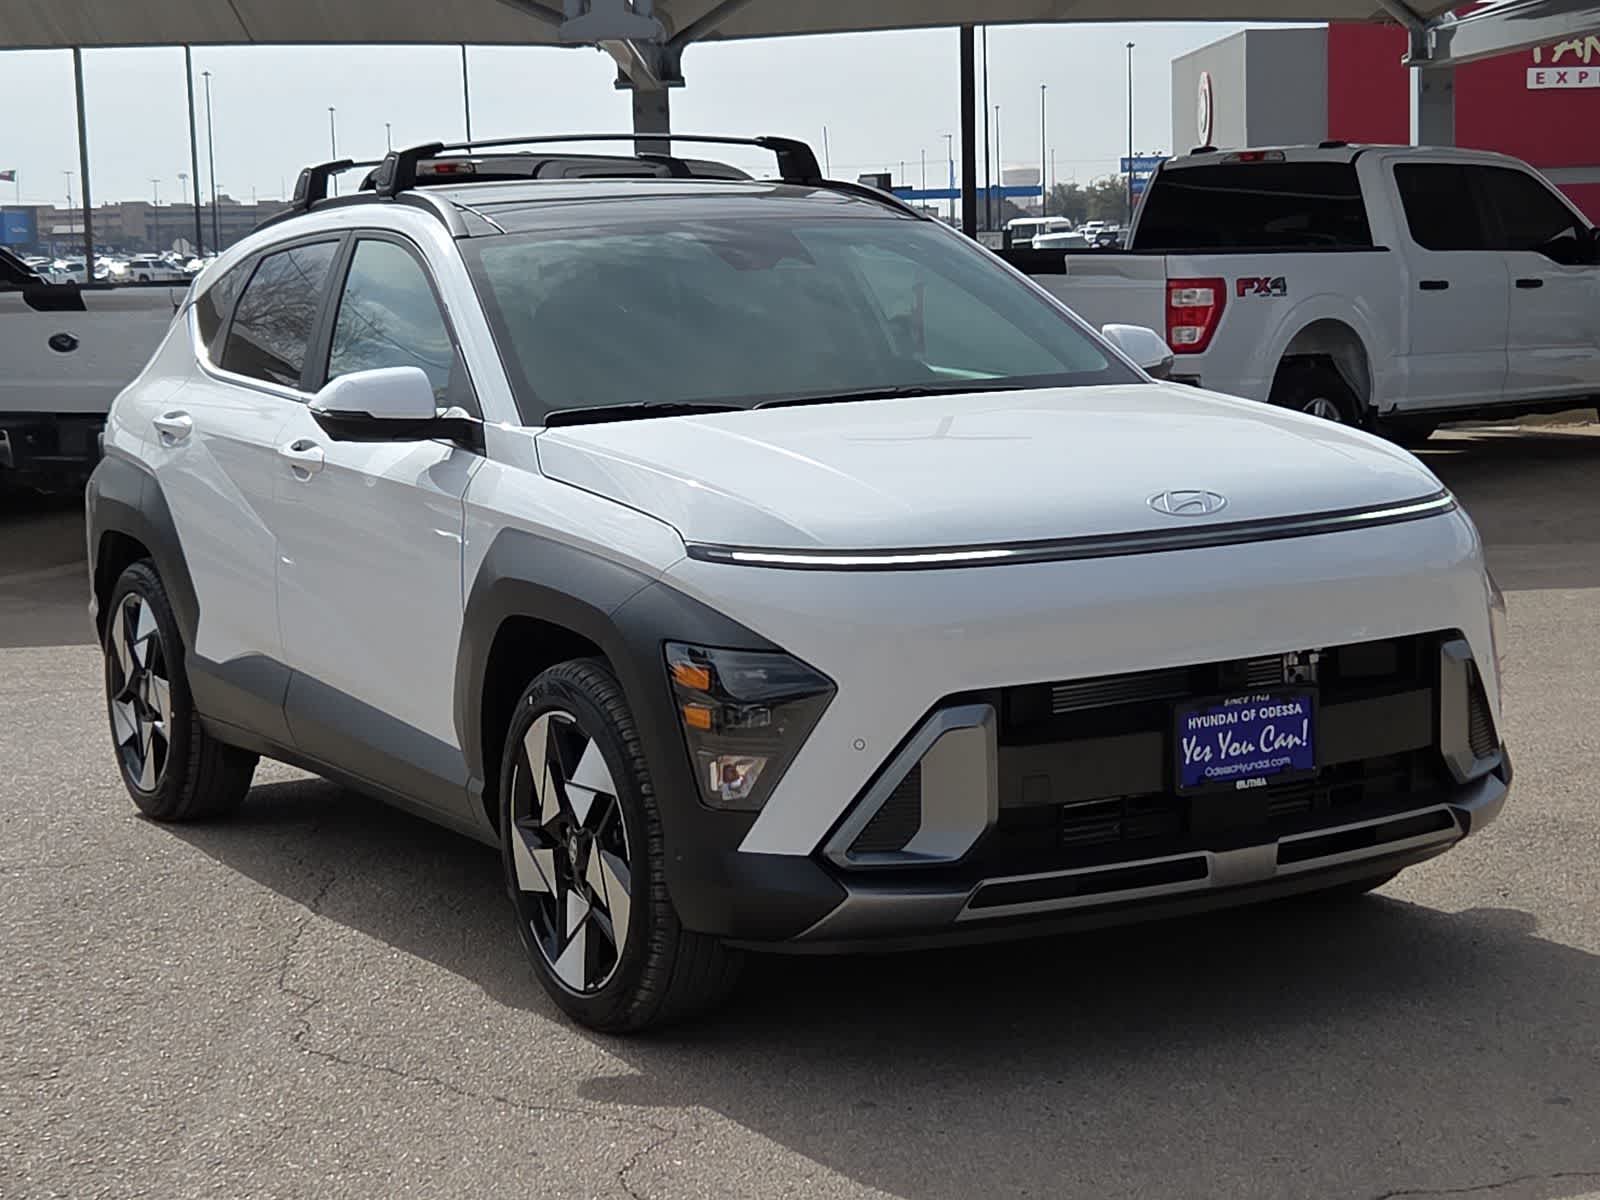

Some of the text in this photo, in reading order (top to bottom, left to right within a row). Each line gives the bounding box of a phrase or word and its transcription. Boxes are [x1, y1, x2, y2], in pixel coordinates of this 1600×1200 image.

[1536, 71, 1600, 85] EXP
[1236, 276, 1287, 297] FX4
[1188, 703, 1303, 730] HYUNDAI OF ODESSA
[1182, 718, 1309, 765] Yes You Can!
